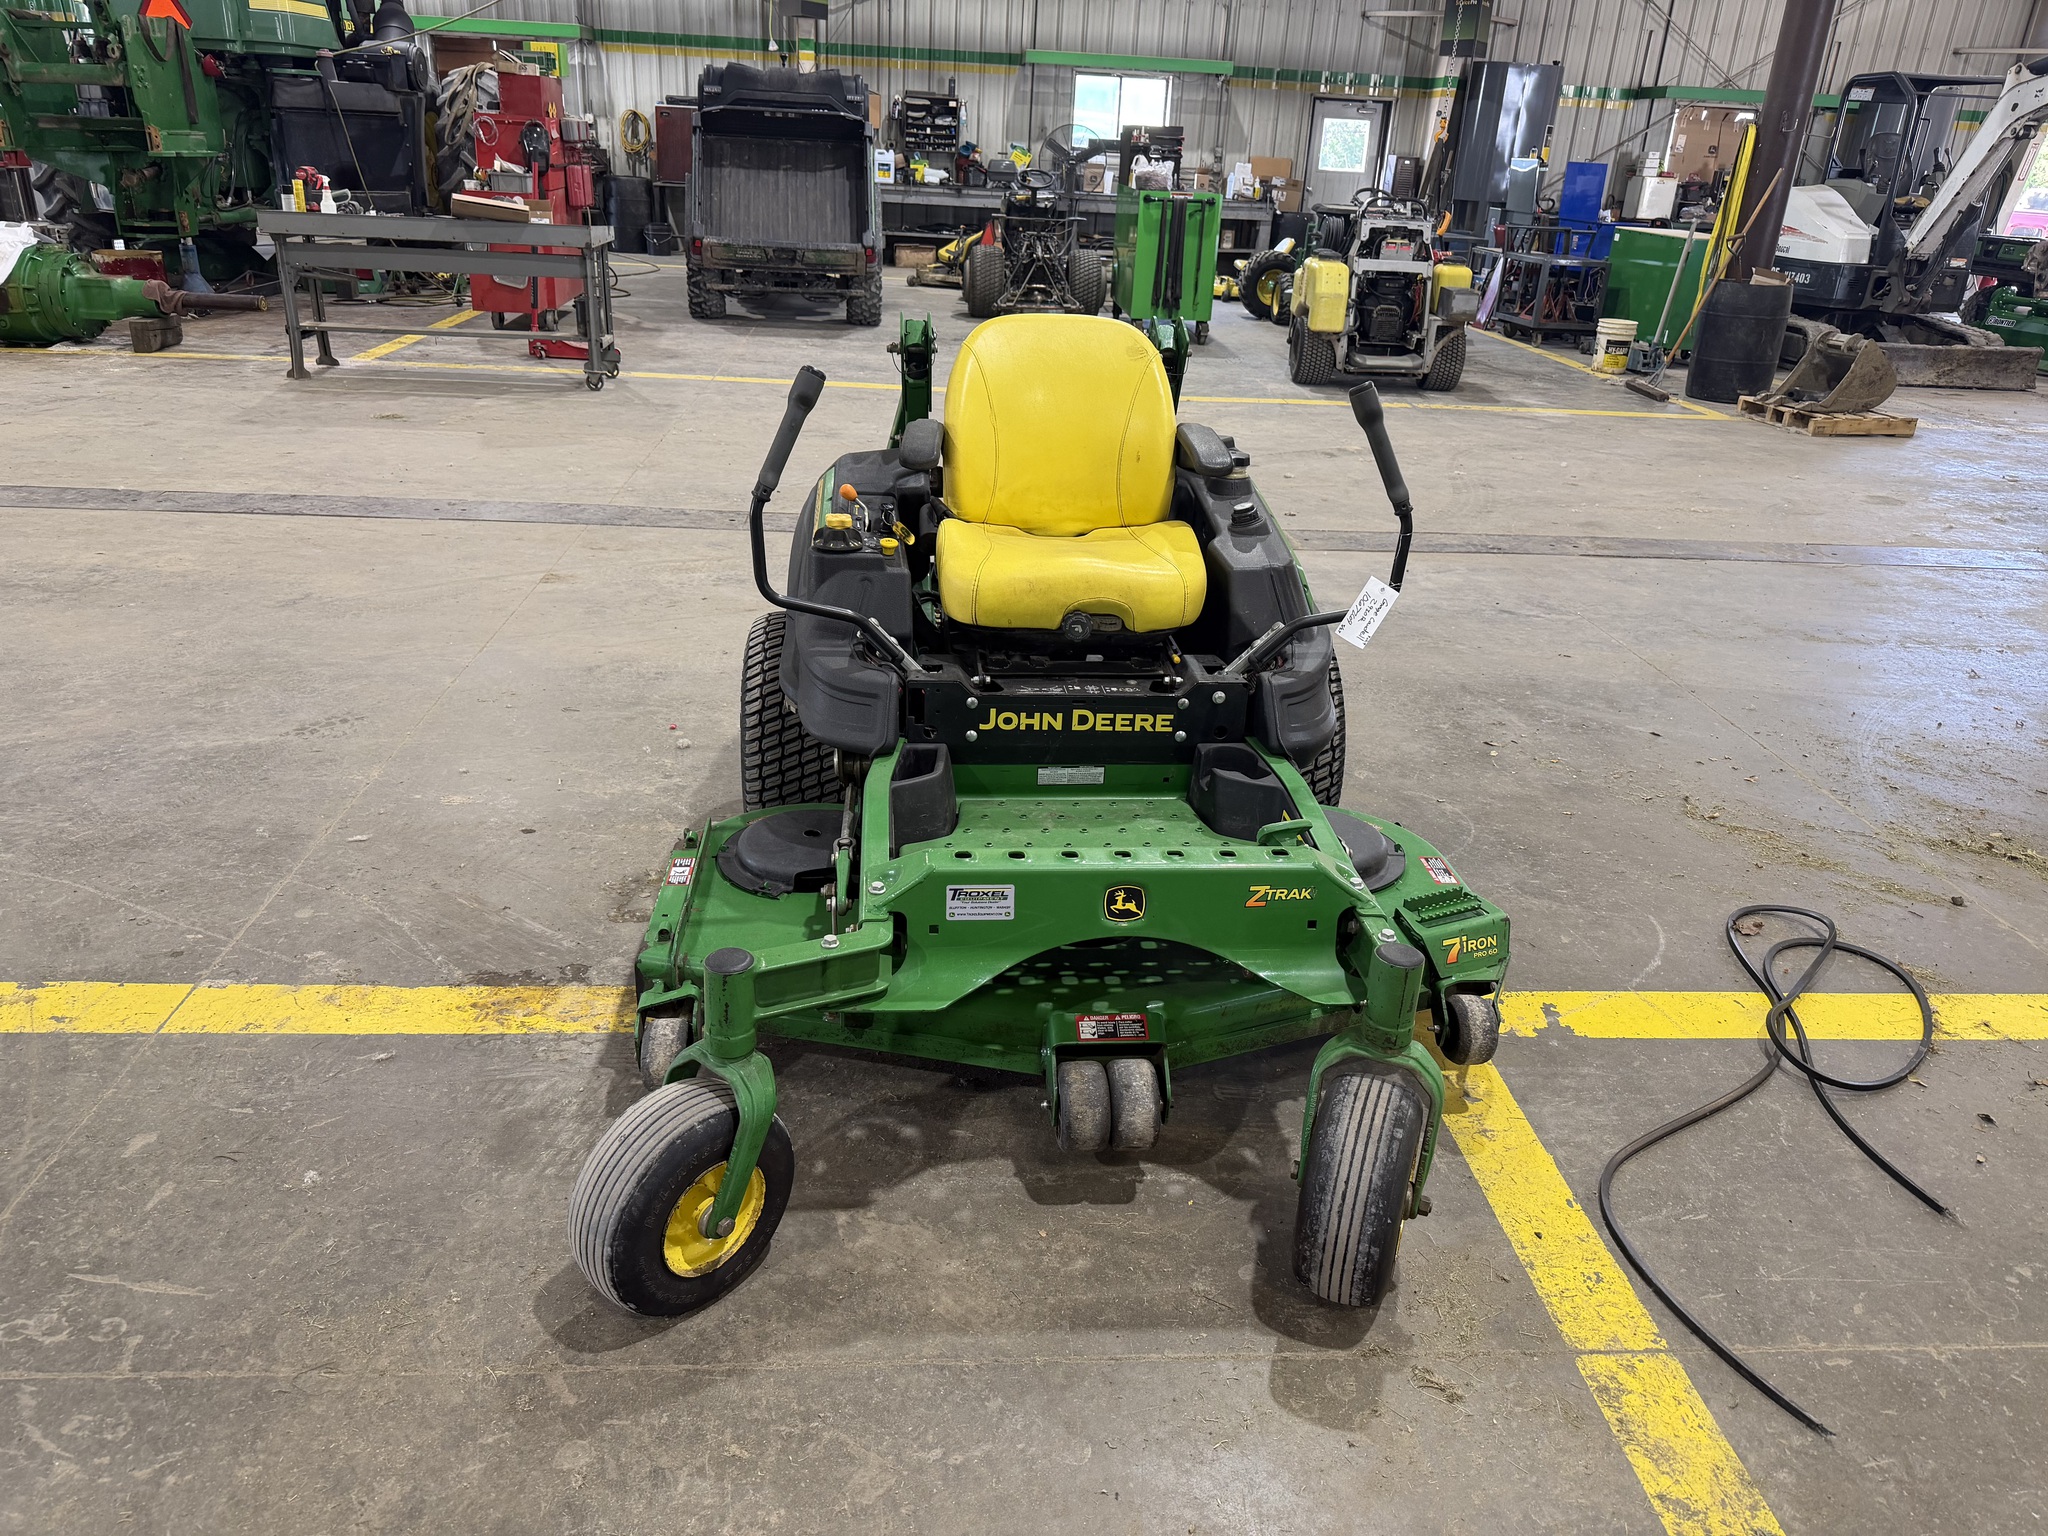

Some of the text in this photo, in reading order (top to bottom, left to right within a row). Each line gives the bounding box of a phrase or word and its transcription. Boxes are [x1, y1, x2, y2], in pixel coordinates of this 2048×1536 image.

[979, 708, 1174, 731] JOHN DEERE
[949, 888, 1009, 901] TROXEL
